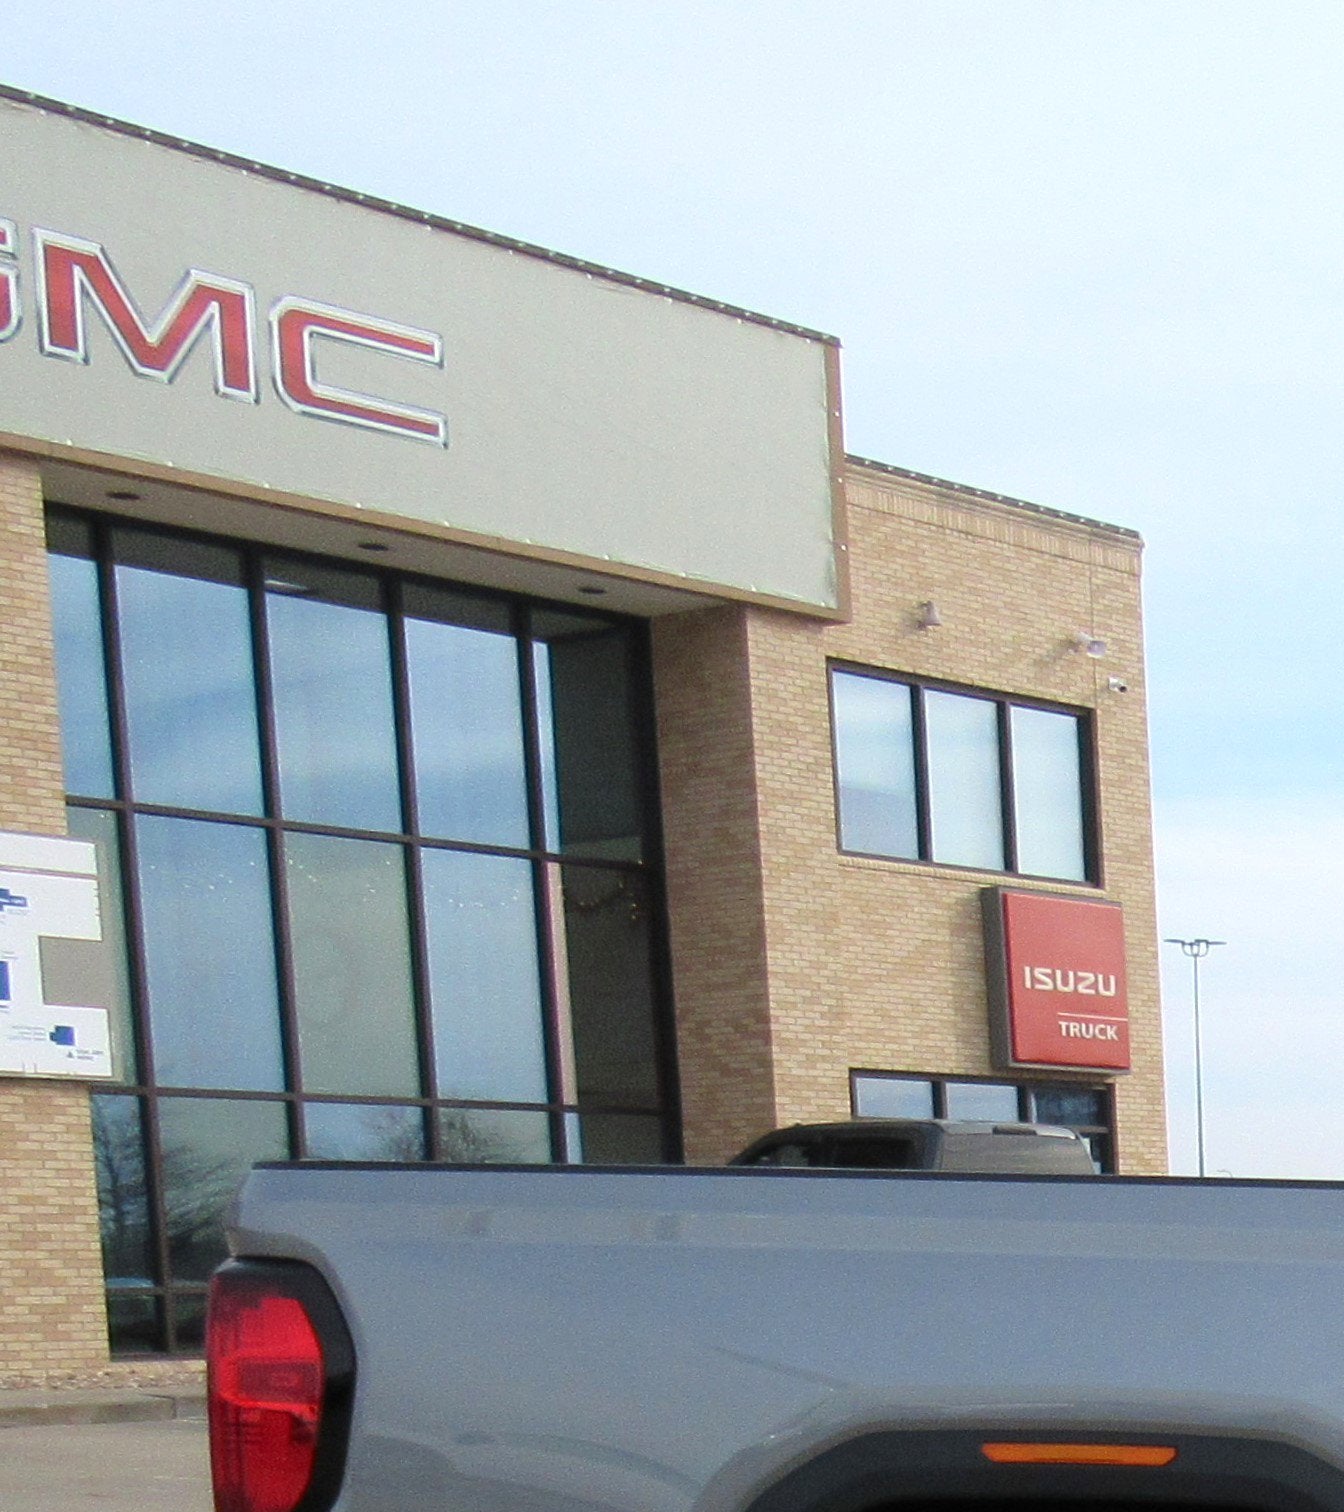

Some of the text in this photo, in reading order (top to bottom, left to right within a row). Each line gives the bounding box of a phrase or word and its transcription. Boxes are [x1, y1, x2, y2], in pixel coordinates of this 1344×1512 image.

[0, 217, 447, 448] MC
[1024, 966, 1116, 996] ISUZU
[1058, 1021, 1118, 1041] TRUCK
